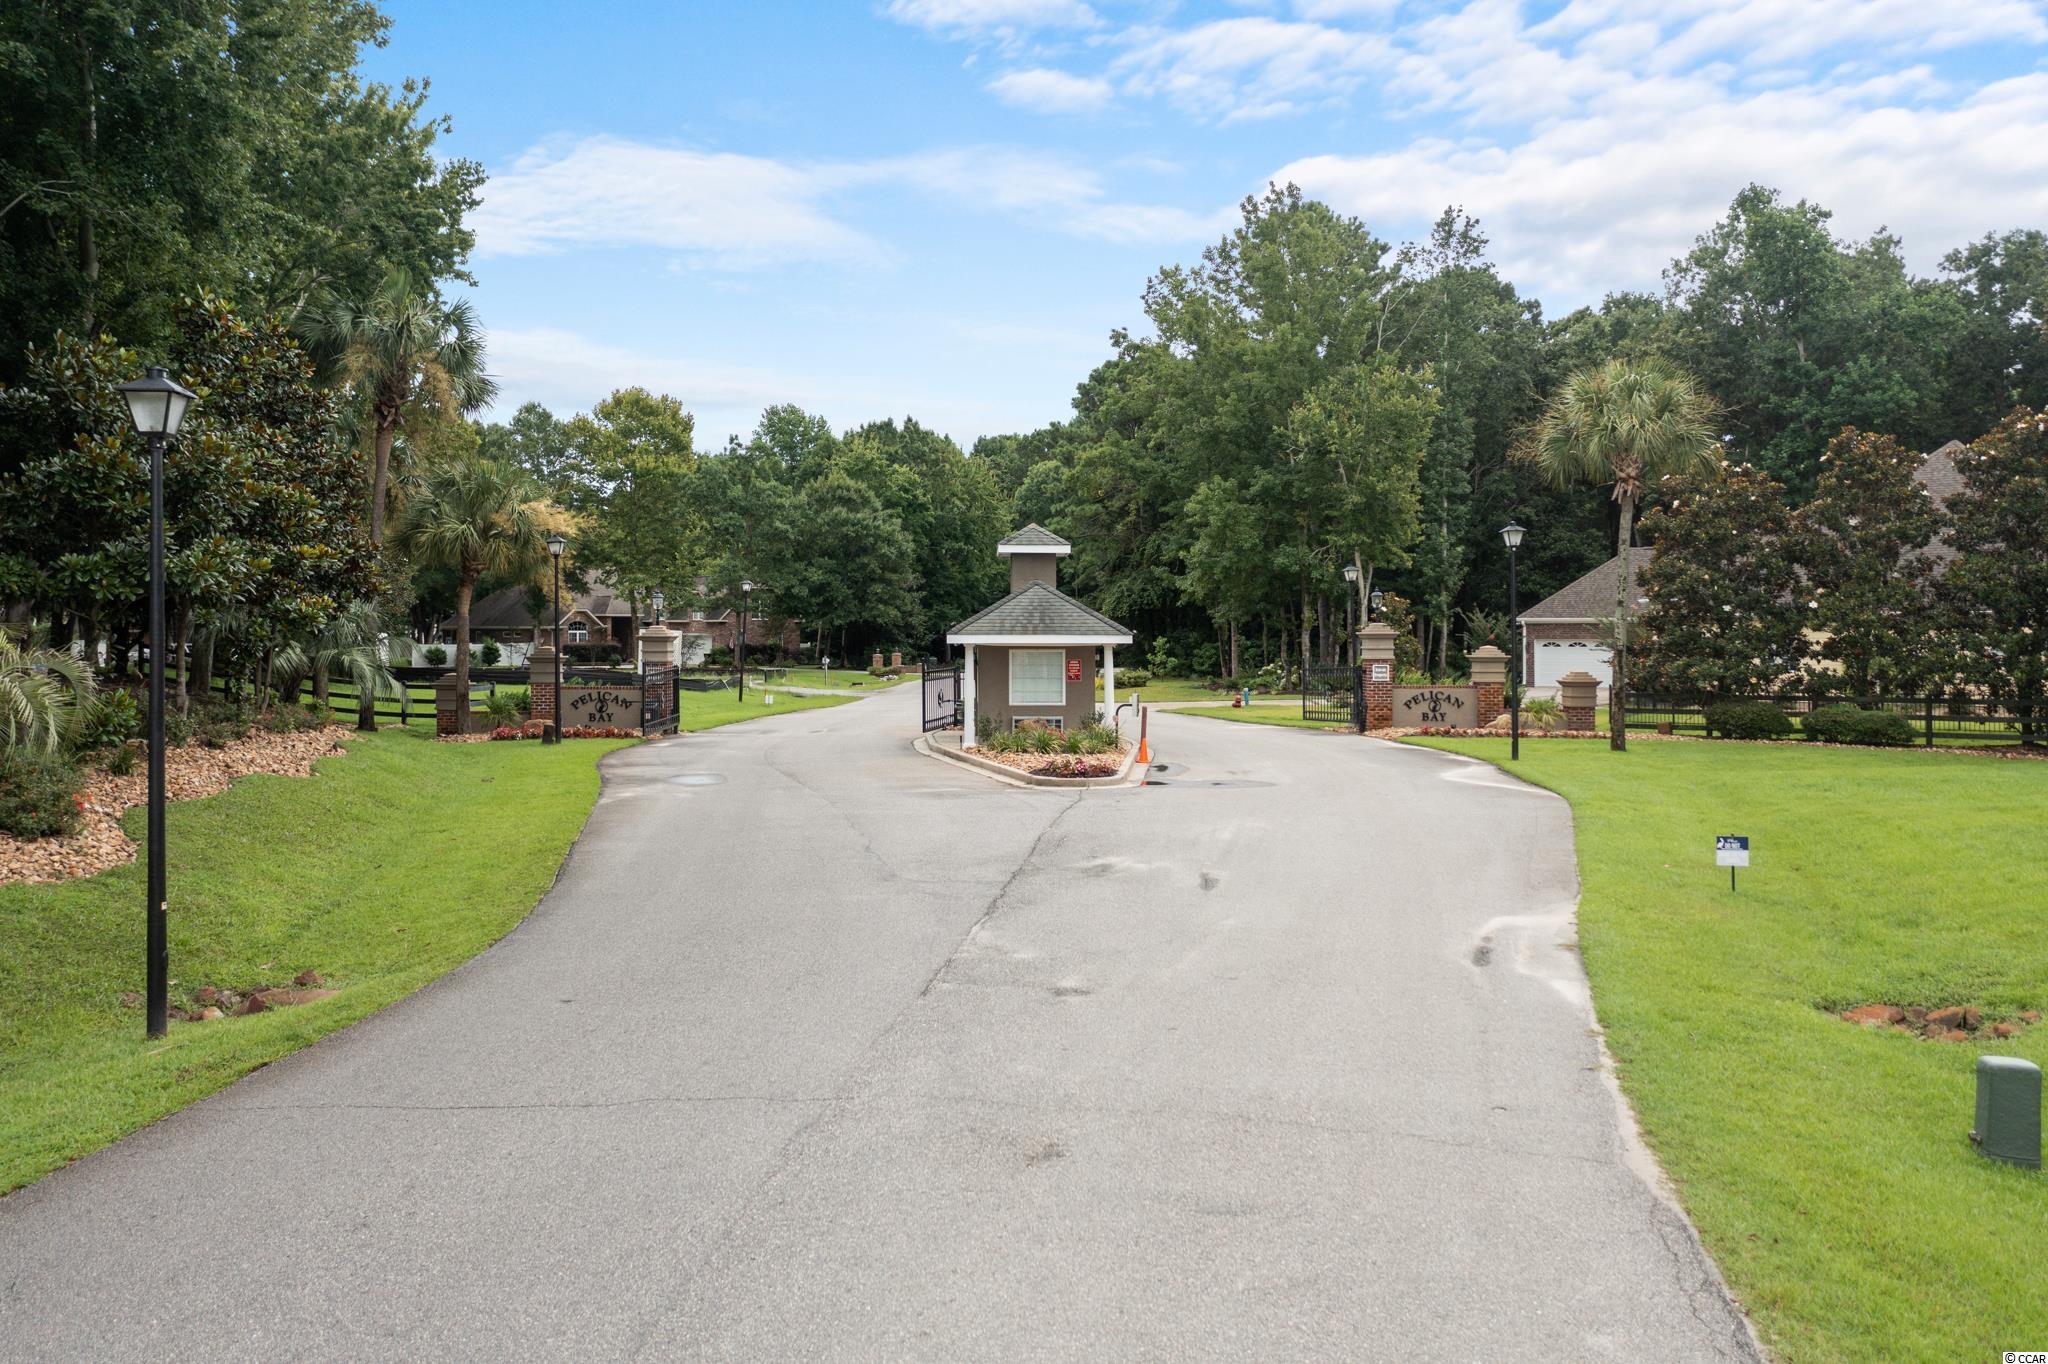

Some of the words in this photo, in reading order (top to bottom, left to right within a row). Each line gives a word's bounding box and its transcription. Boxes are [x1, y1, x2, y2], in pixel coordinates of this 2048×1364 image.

[570, 691, 632, 710] PELICAN
[1403, 690, 1465, 710] PELICAN
[588, 713, 614, 722] BAY
[1421, 712, 1447, 722] BAY
